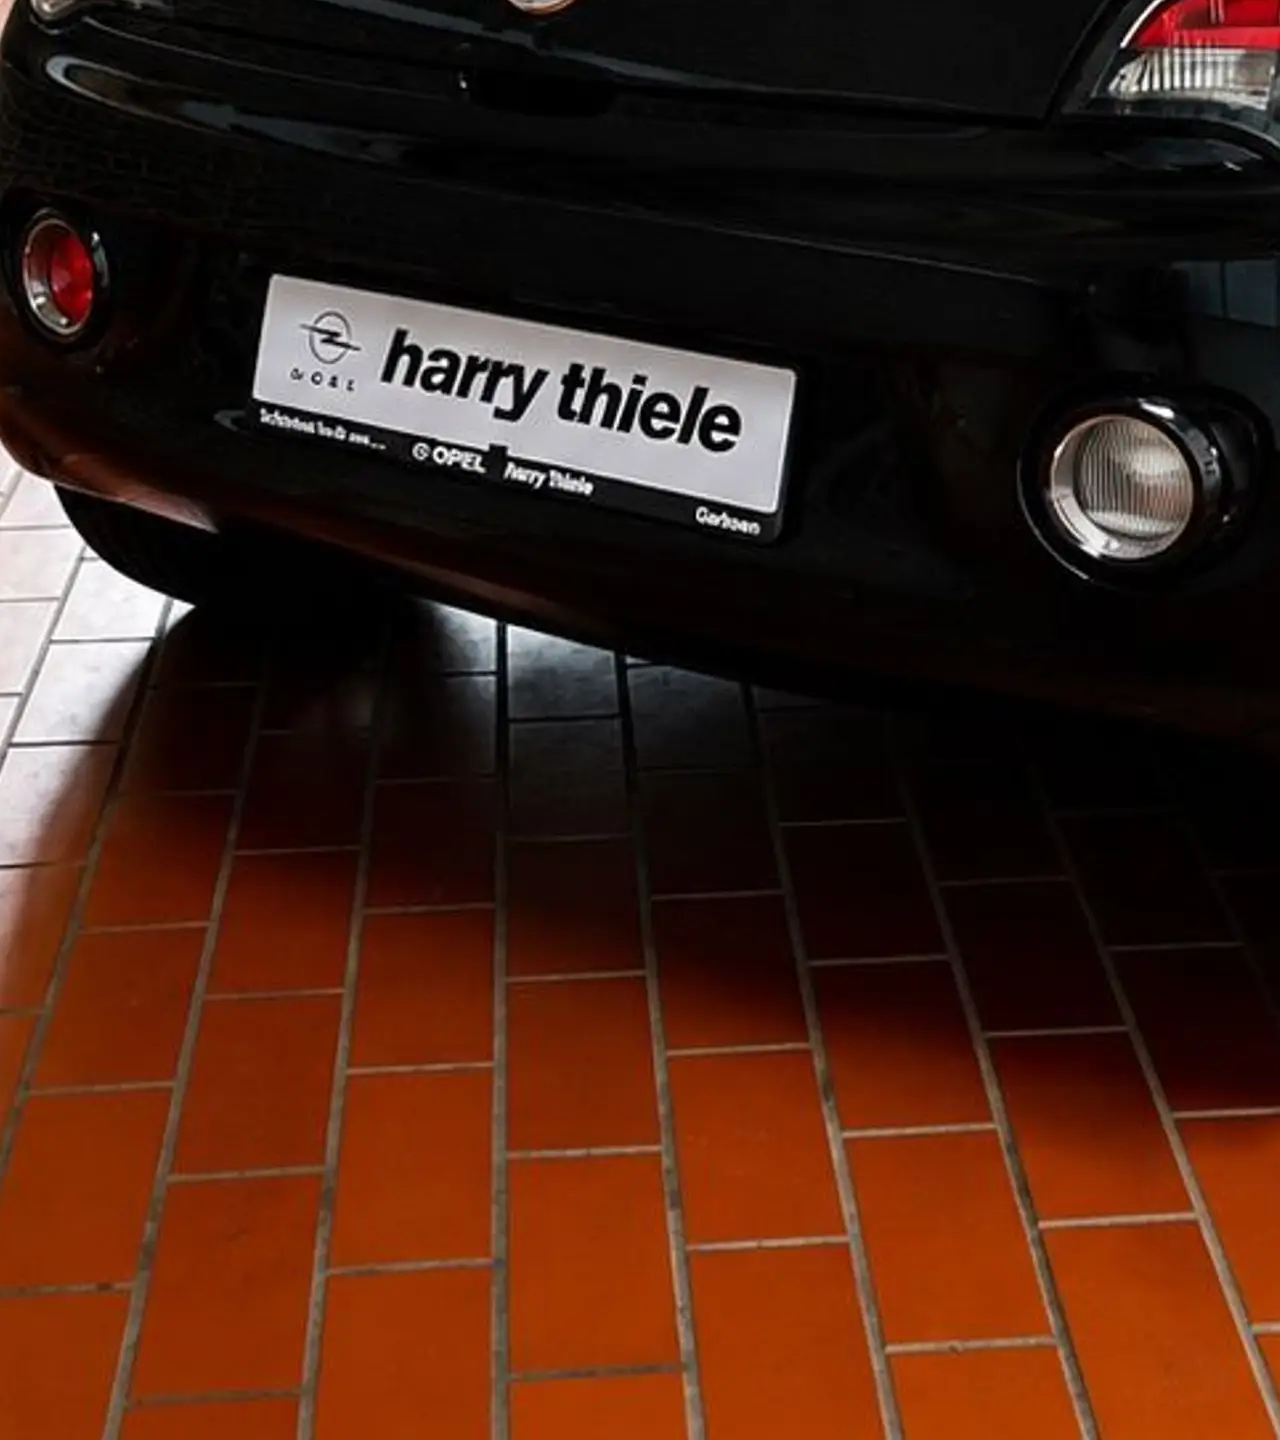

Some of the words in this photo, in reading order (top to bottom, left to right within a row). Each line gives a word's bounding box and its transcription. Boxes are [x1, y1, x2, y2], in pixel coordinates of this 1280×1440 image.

[380, 327, 550, 422] harry
[557, 362, 742, 453] thiele
[432, 445, 486, 474] OPEL
